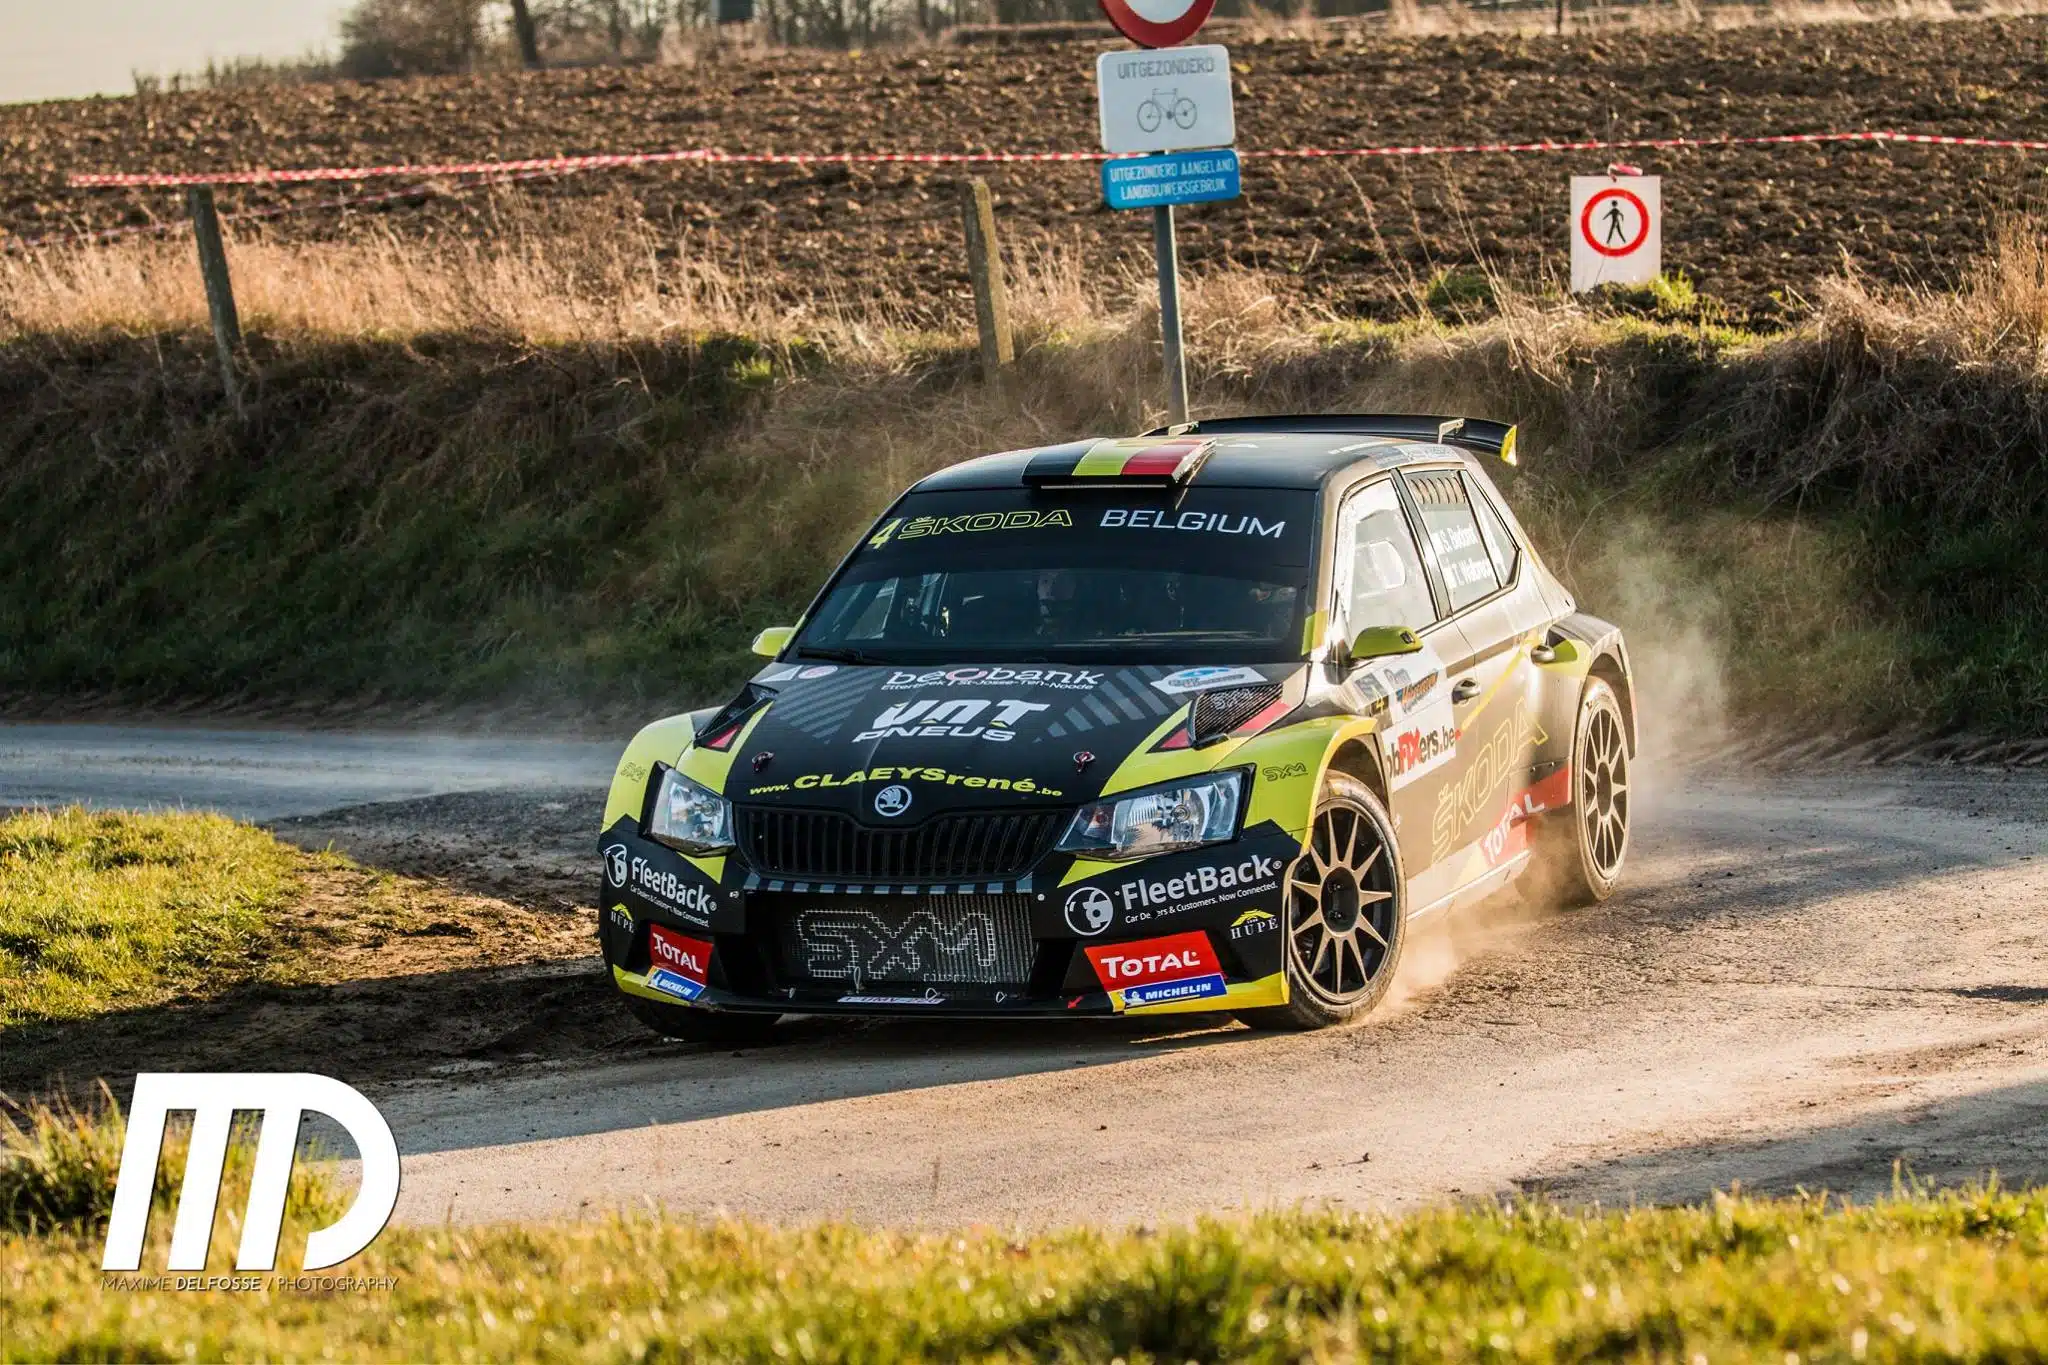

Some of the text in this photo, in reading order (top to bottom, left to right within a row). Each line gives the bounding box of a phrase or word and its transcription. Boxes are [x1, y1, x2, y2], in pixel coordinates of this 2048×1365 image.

[1117, 57, 1215, 79] UITGEZONDERD
[1110, 158, 1235, 182] UITGEZONDERD AANGELAND
[1120, 177, 1227, 200] LANDBOUWERSGEBRUIK
[868, 518, 901, 549] 4
[1100, 509, 1286, 539] BELGIUM
[851, 726, 1017, 743] PNEUS
[1262, 761, 1308, 782] SXM
[1125, 914, 1139, 925] Car
[1140, 906, 1168, 921] Deers
[1176, 896, 1218, 913] Customers.
[1219, 891, 1236, 902] Now
[1237, 880, 1279, 900] Connected.
[652, 932, 704, 974] TOTAL
[797, 909, 996, 980] SXM
[1100, 950, 1201, 979] TOTAL
[1145, 982, 1212, 1001] MICHELIN
